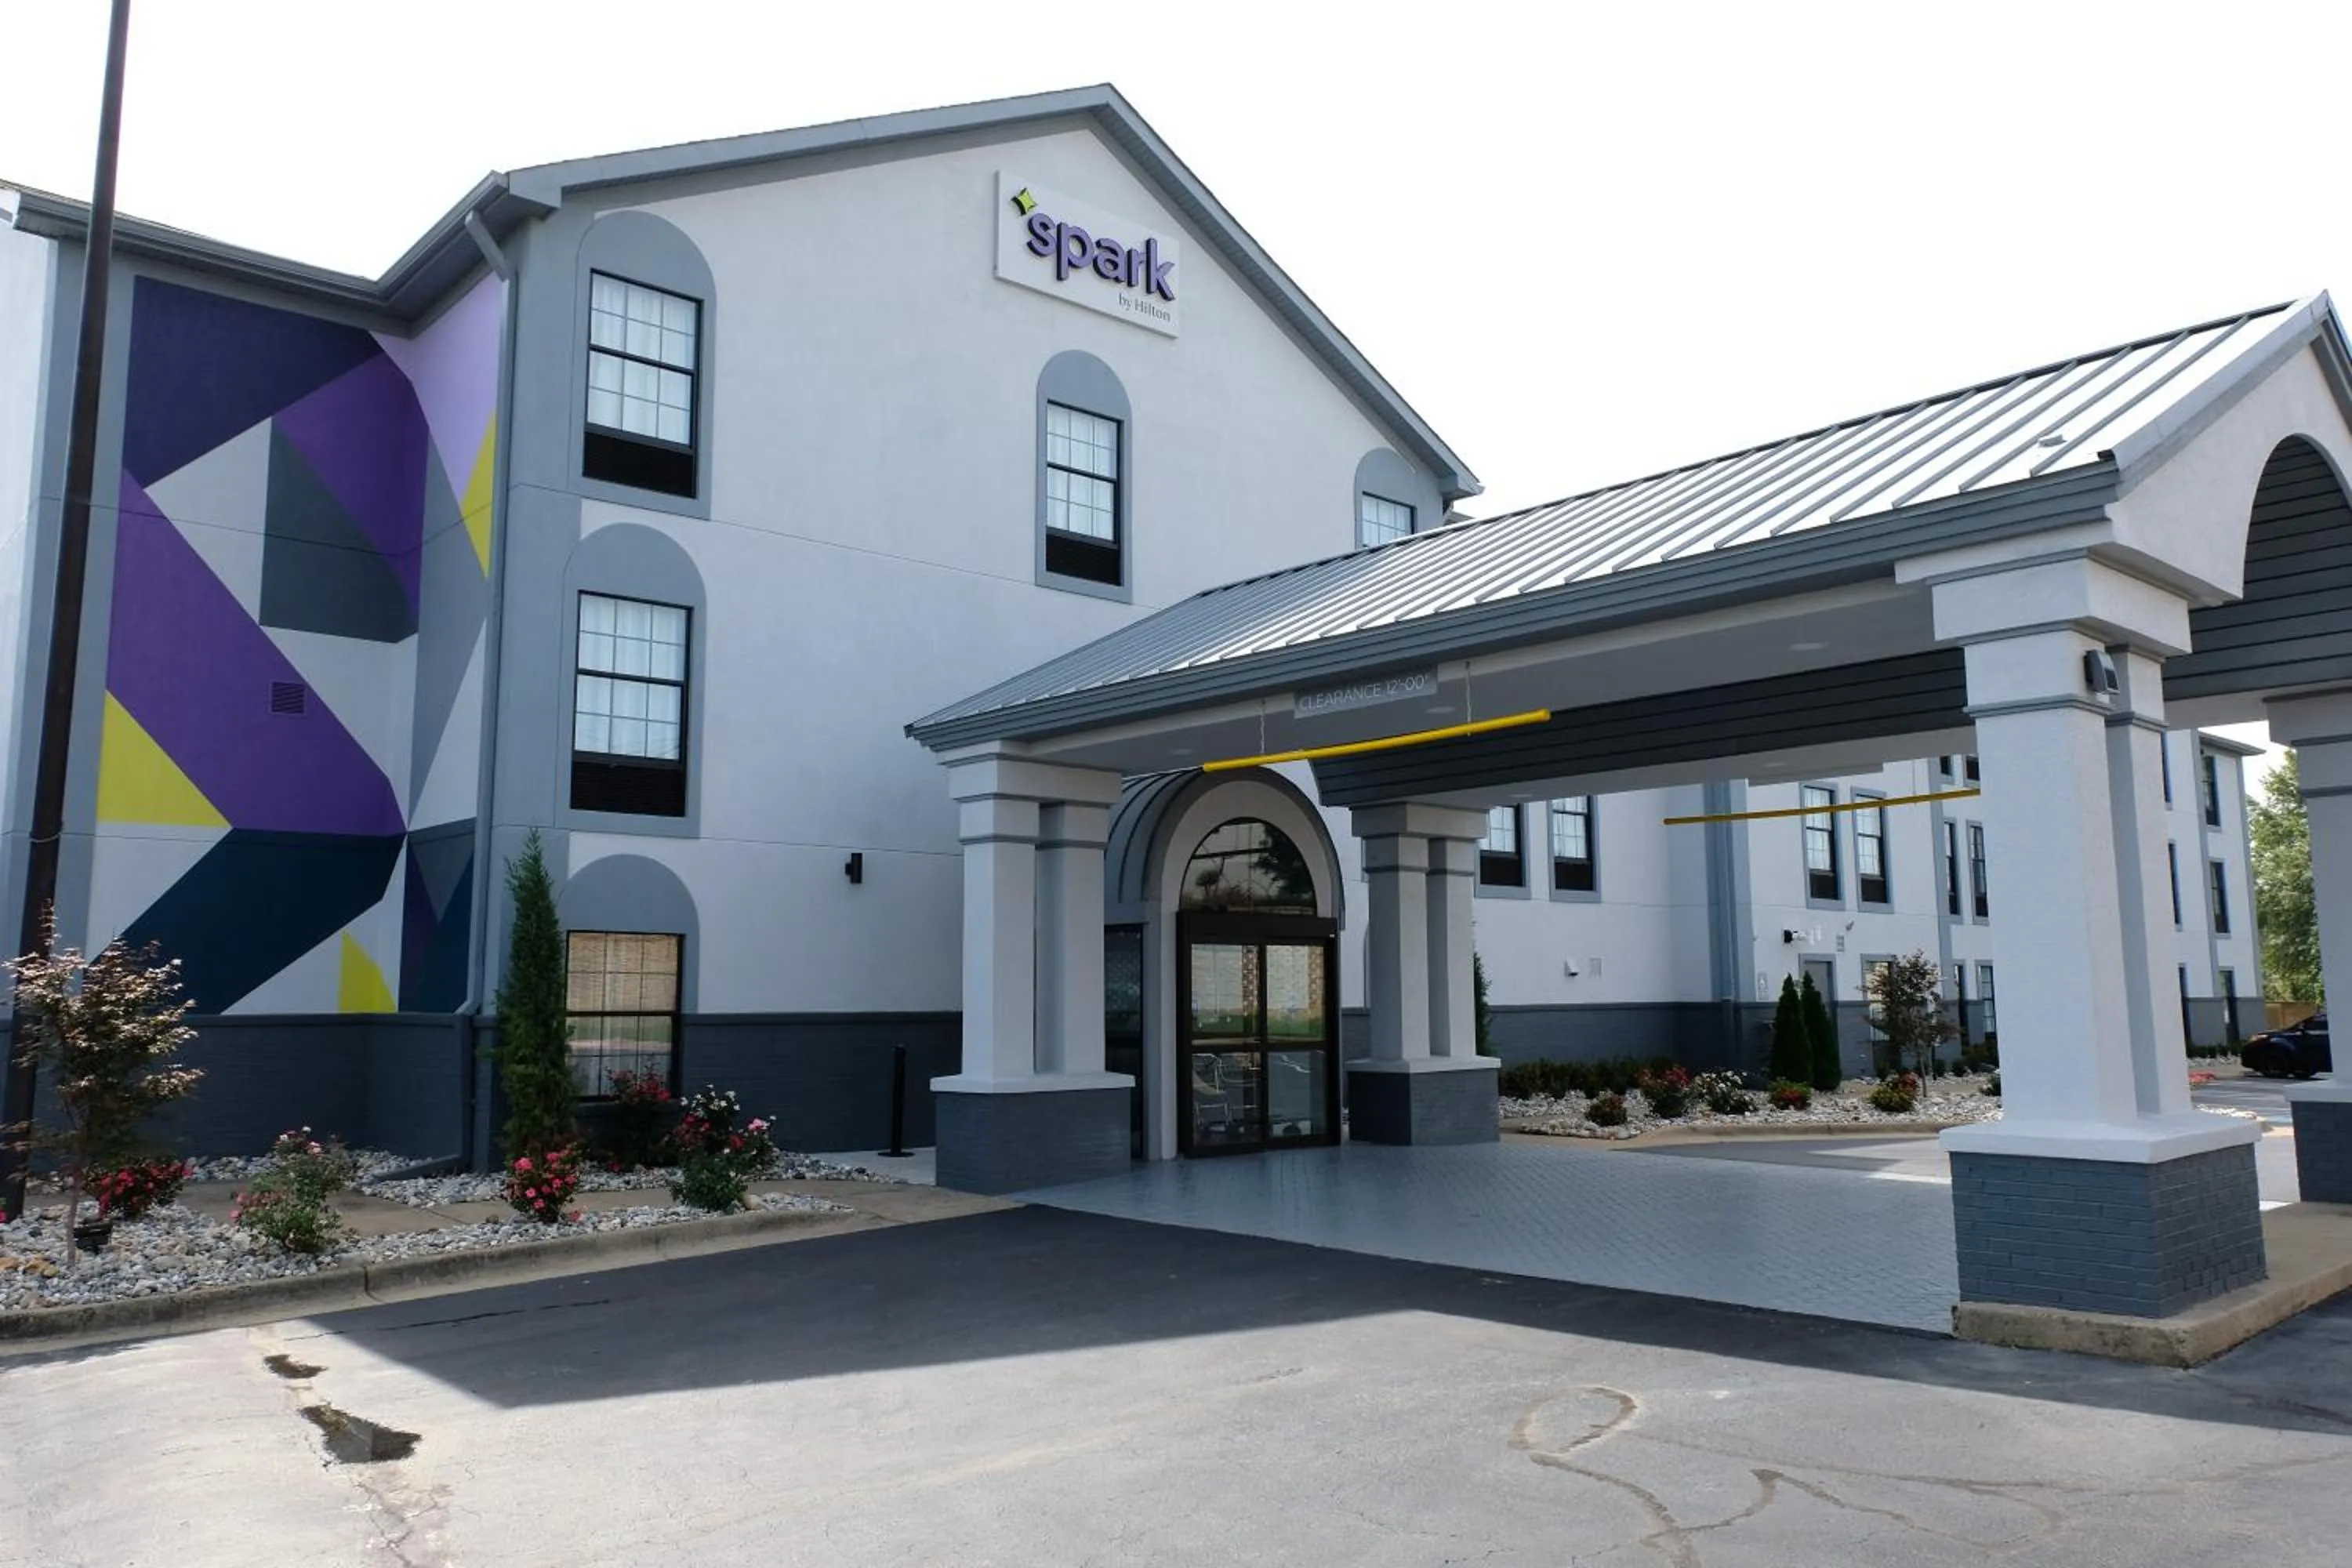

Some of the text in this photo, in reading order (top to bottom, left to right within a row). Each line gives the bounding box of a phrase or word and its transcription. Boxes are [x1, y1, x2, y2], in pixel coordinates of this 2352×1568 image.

[1027, 212, 1174, 301] spark
[1119, 292, 1171, 321] by Hilton
[1299, 684, 1381, 710] CLEARANCE
